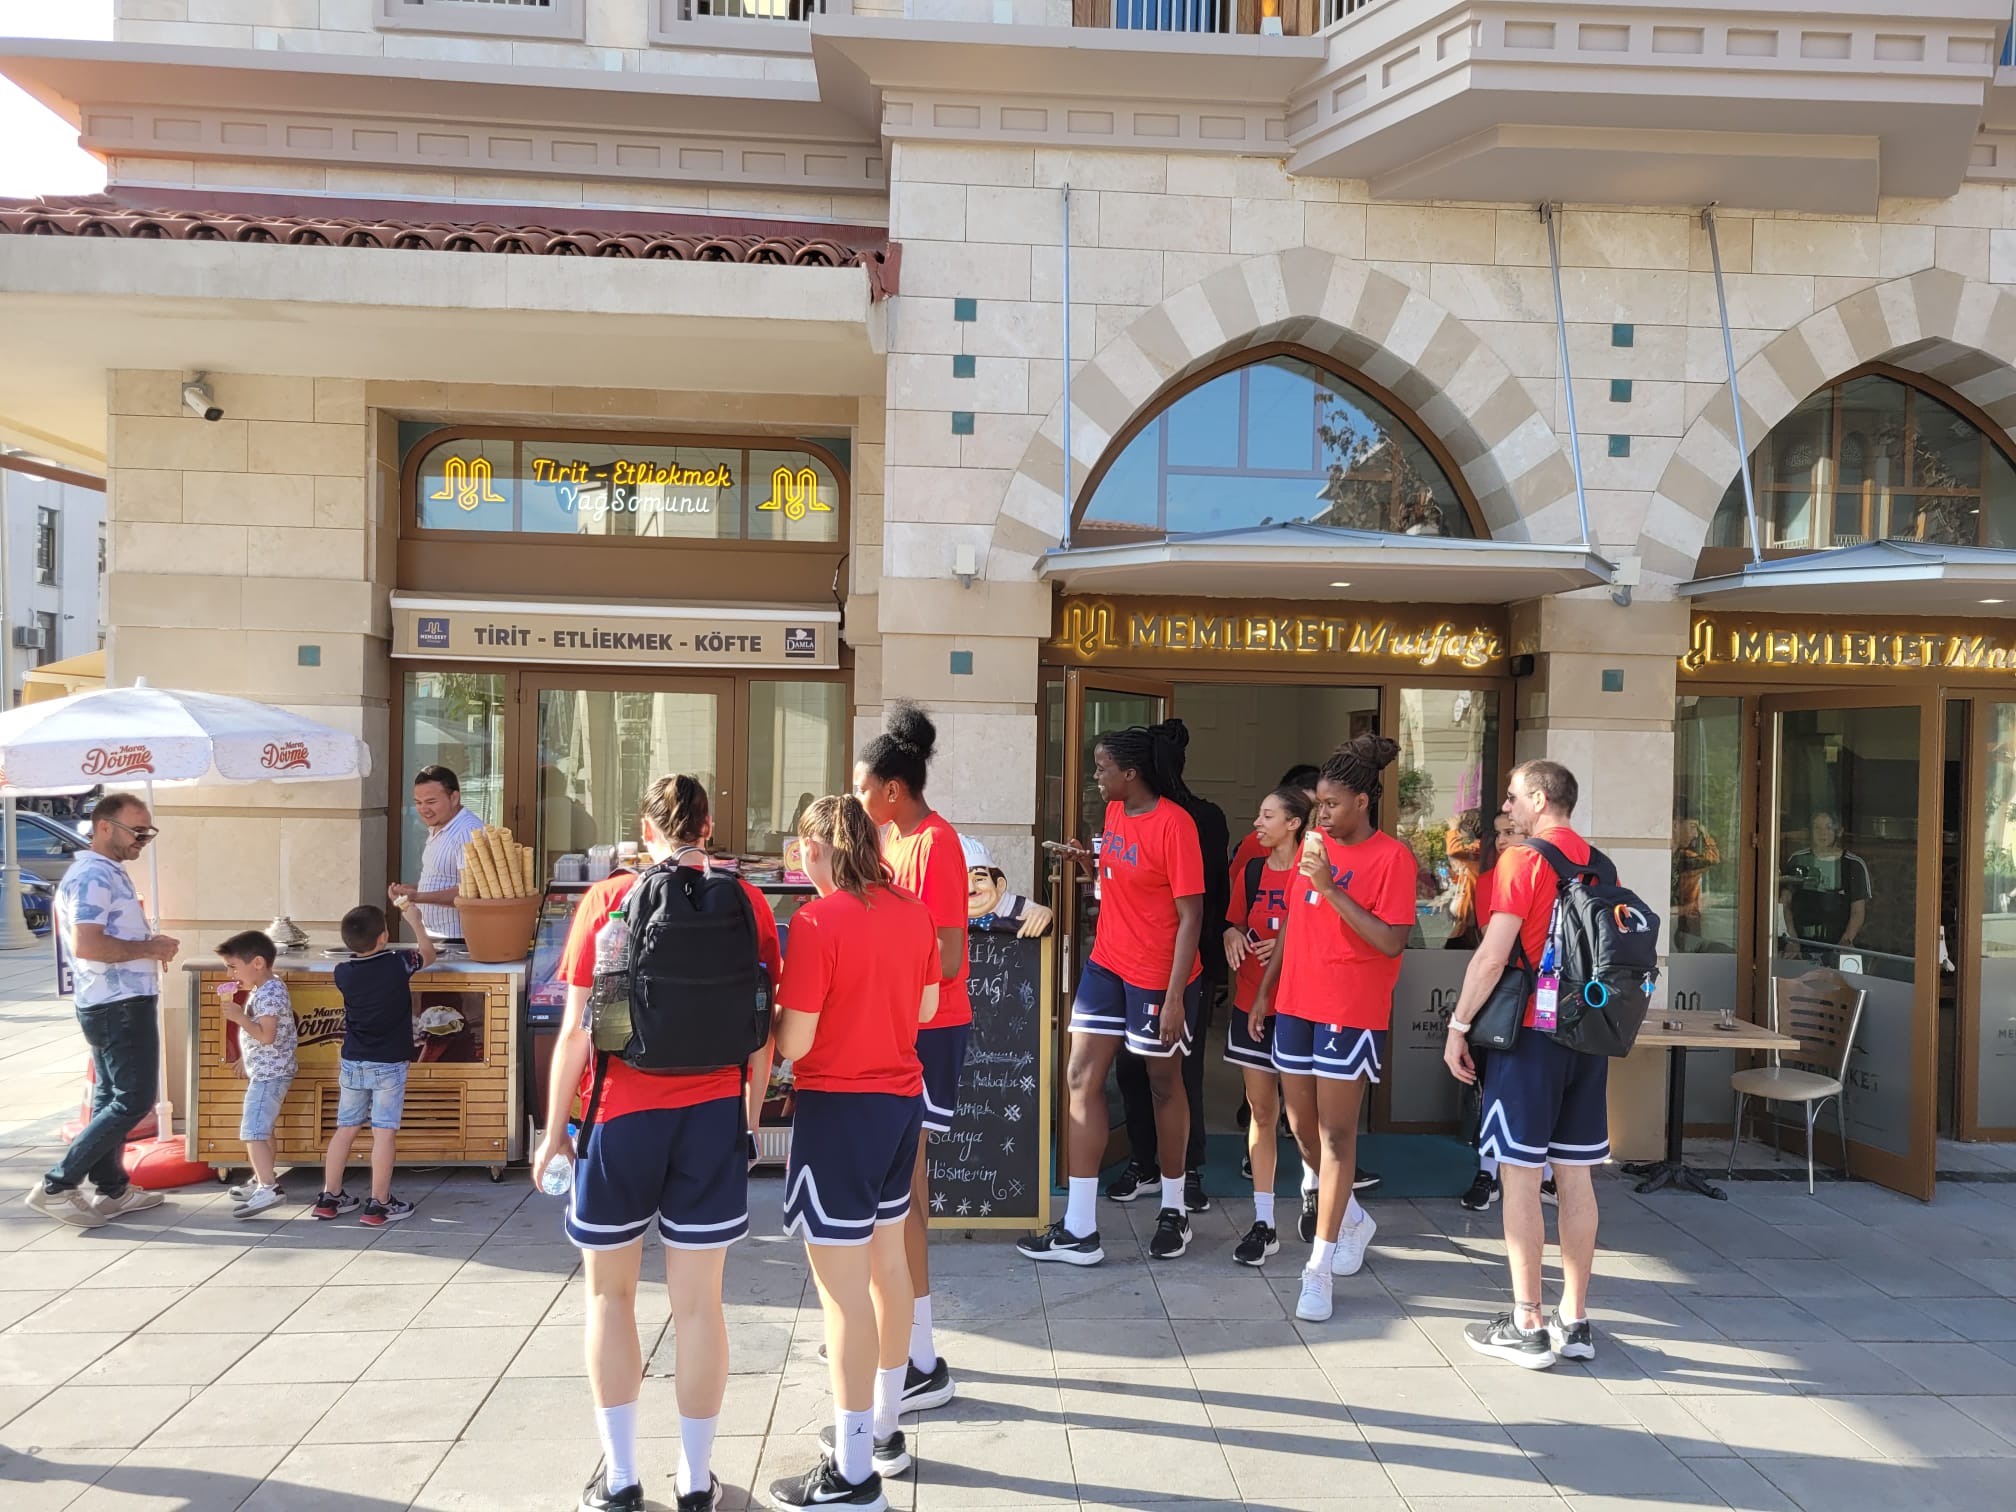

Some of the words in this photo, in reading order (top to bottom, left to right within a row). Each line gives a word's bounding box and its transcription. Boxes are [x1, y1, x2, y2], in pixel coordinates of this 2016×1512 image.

[532, 459, 590, 483] Tirit
[612, 460, 732, 488] Etliekmek
[474, 624, 531, 646] TİRİT
[553, 628, 673, 651] ETLİEKMEK
[694, 632, 762, 653] KÖFTE
[786, 639, 814, 650] DAMLA
[1131, 615, 1345, 652] MEMLEKET
[1731, 629, 1945, 667] MEMLEKET
[81, 748, 153, 776] Dövme
[1101, 831, 1137, 867] FRA
[1256, 889, 1287, 910] FR
